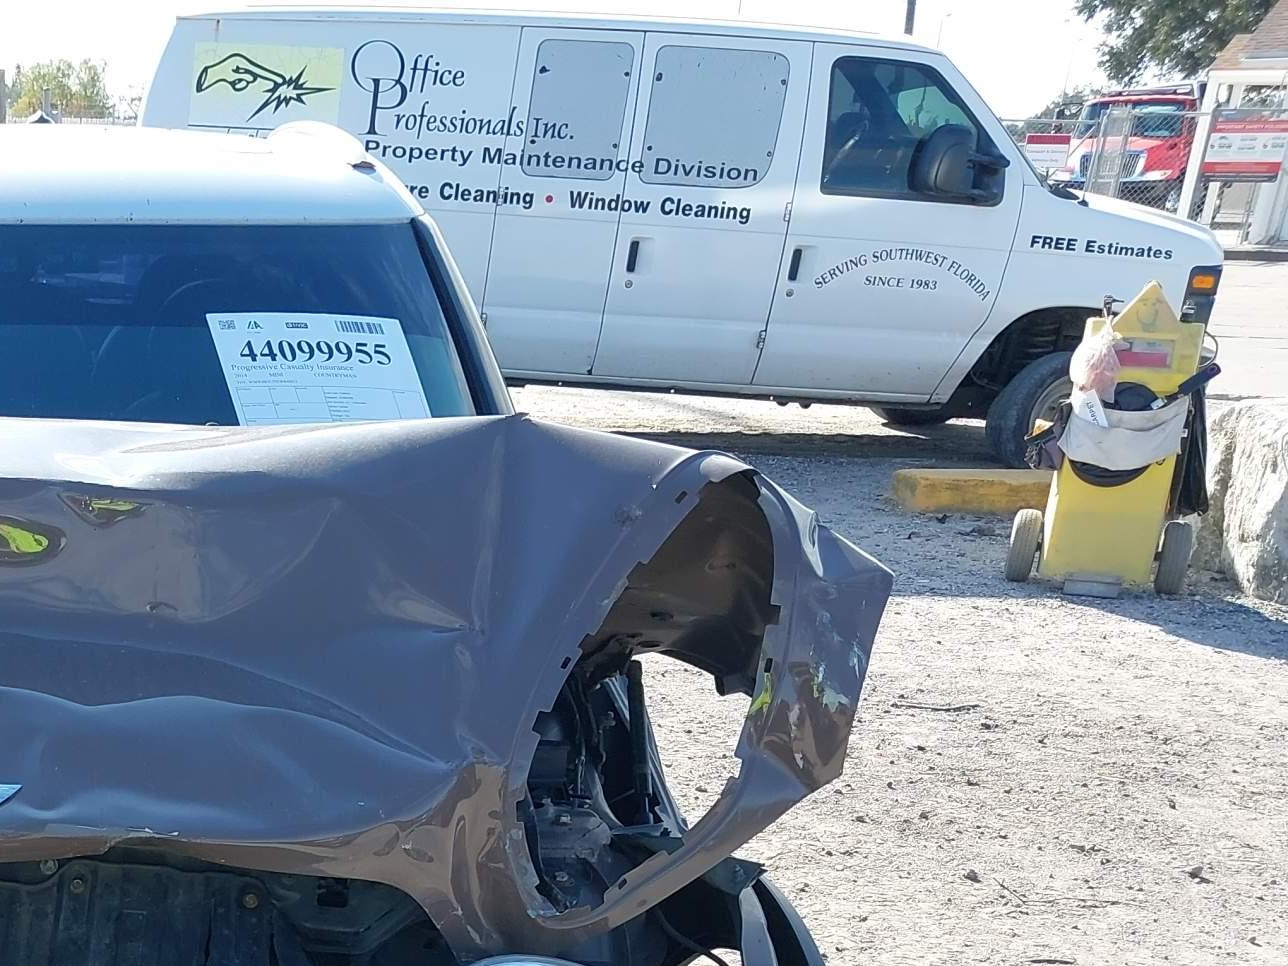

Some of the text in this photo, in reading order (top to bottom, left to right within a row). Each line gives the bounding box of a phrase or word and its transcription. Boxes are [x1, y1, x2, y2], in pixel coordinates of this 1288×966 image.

[351, 40, 465, 93] Office
[358, 77, 574, 140] Professionals Inc.
[365, 140, 758, 182] Property Maintenance Division
[439, 182, 534, 209] Cleaning
[569, 190, 651, 214] Window
[660, 197, 751, 225] Cleaning
[1030, 235, 1173, 260] FREE Estimates
[814, 248, 991, 302] SERVING SOUTHWEST FLORIDA
[863, 275, 938, 291] SINCE 1983
[231, 363, 355, 372] Progressive Casualty Insurance
[239, 339, 392, 366] 44099955
